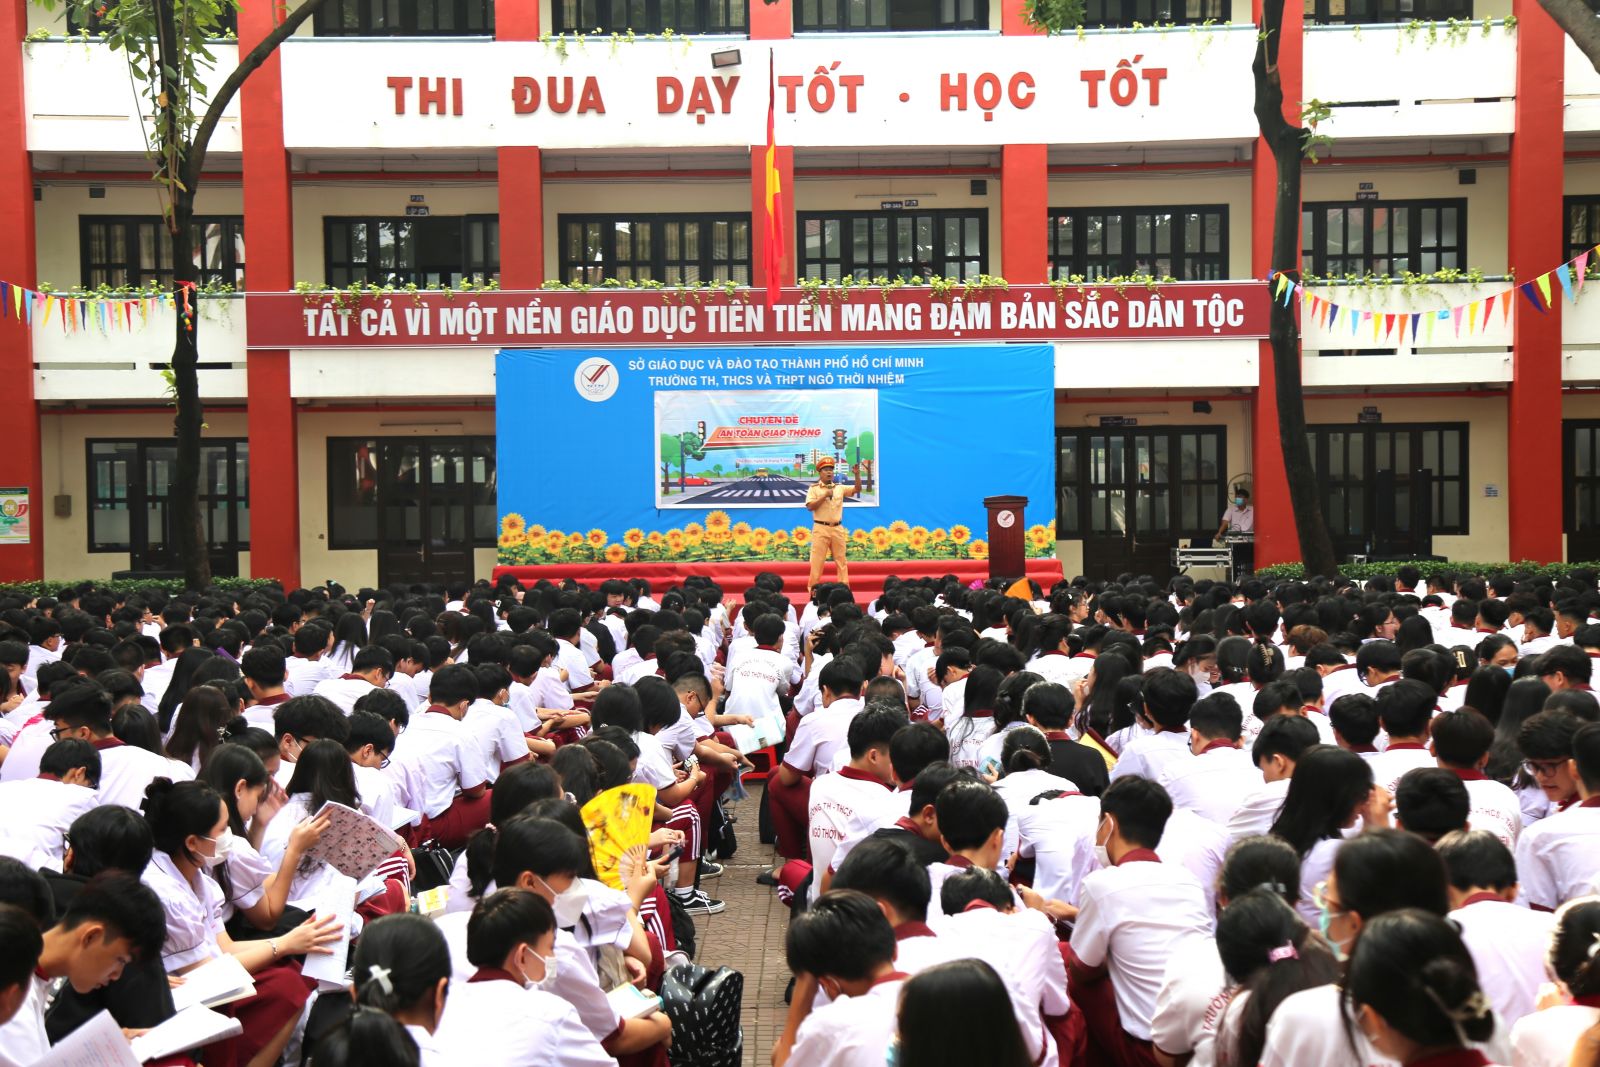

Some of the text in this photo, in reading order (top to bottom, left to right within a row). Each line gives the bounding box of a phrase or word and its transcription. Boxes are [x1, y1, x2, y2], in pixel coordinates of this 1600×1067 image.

[387, 55, 1168, 124] THI ĐUA DẠY TỐT HỌC TỐT
[303, 290, 1244, 341] TẤT CẢ VÌ MỘT NỀN GIÁO DỤC TIÊN TIẾN MANG ĐẬM BẢN SẮC DÂN TỘC
[628, 354, 924, 371] SỞ GIÁO DỤC VÀ ĐÀO TẠO THÀNH PHỐ HỒ CHÍ MINH
[648, 372, 905, 387] TRƯỜNG TH, THCS VÀ THPT NGÔ THỜI NHIỆM
[739, 413, 799, 424] CHUYÊN ĐỀ
[720, 427, 822, 437] AN TOÀN GIAO THÔNG
[823, 802, 832, 810] TH
[836, 803, 853, 817] THCS
